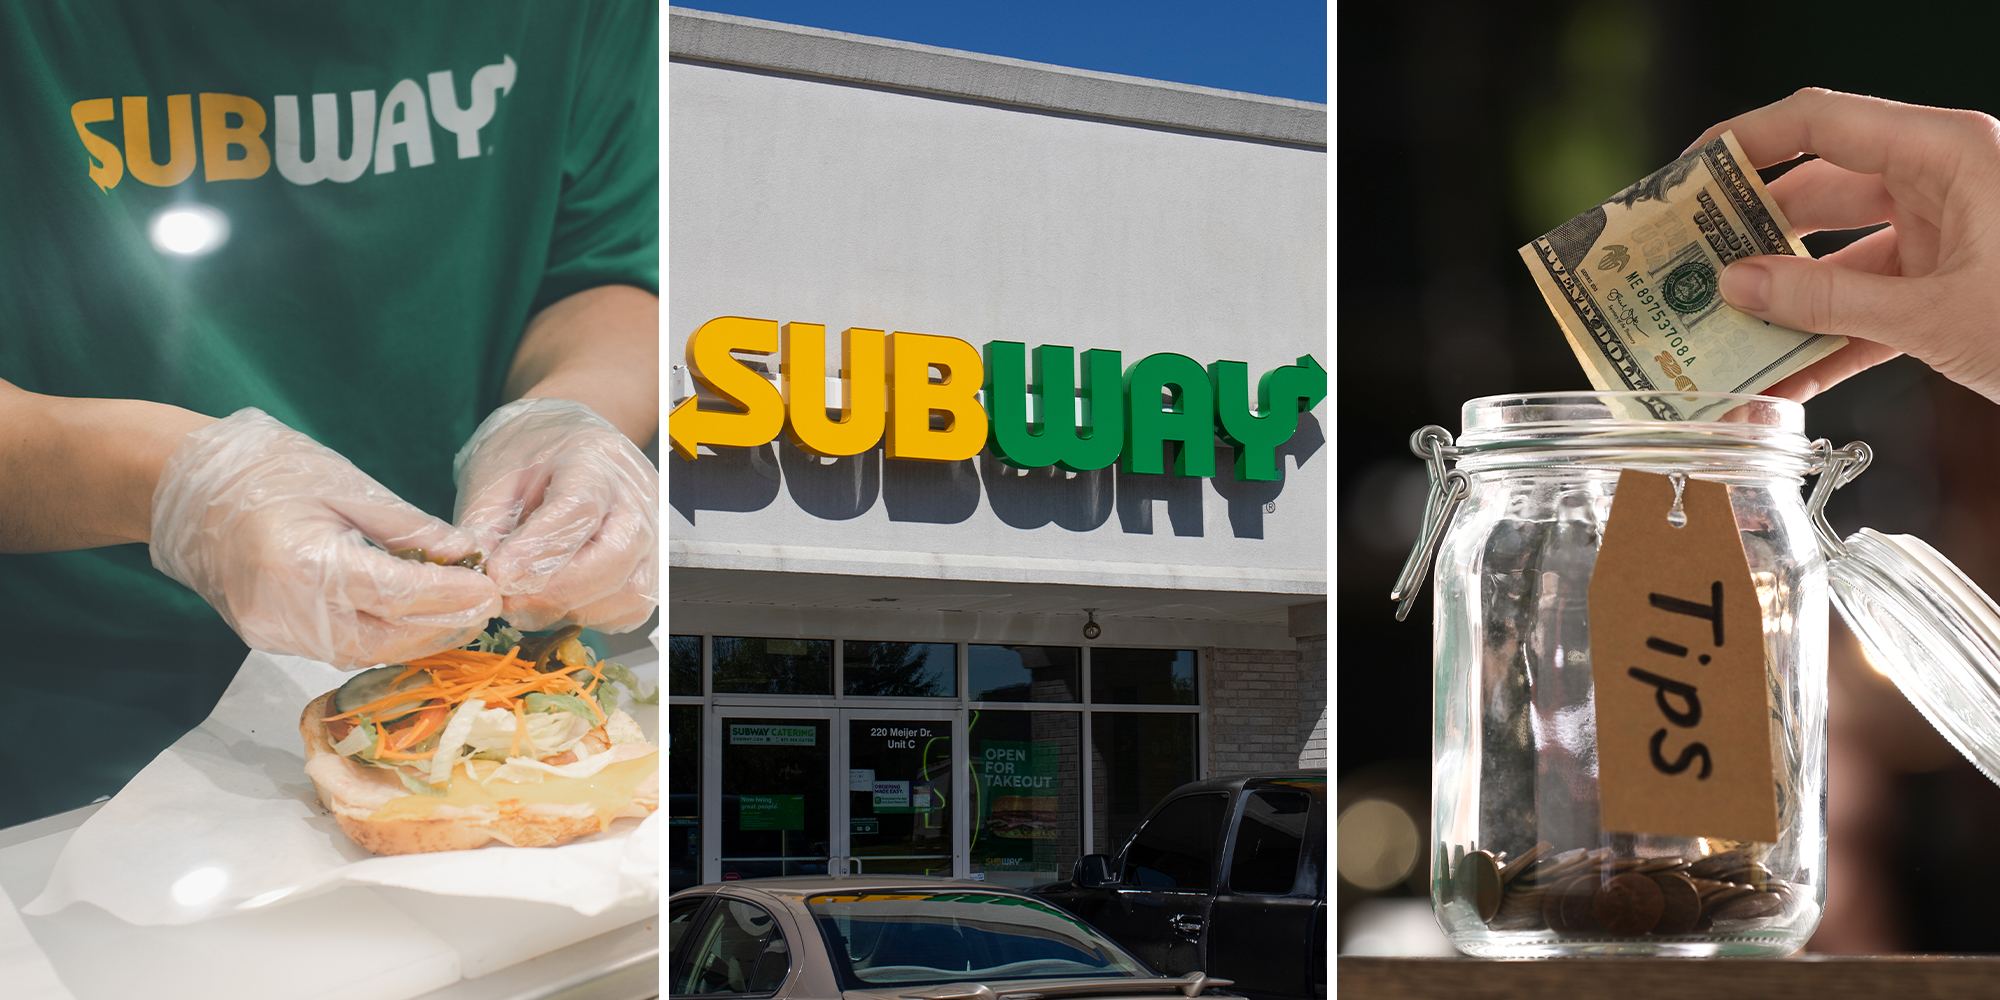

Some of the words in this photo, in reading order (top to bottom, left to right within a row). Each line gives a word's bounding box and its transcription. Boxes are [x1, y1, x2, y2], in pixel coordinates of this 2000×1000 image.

[71, 54, 517, 195] SUBWAY
[1716, 152, 1756, 210] RESERVE
[1695, 187, 1745, 254] UNITED
[1738, 232, 1757, 256] THE
[1535, 235, 1601, 328] TWENTY
[1654, 349, 1700, 403] 20
[669, 316, 1327, 481] SUBWAY
[1628, 581, 1724, 780] Tips
[732, 727, 770, 736] SUBWAY
[771, 728, 814, 737] CATERING
[870, 727, 888, 737] 220
[889, 728, 918, 738] Meijer
[920, 728, 933, 737] Dr.
[887, 739, 906, 749] Unit
[907, 740, 916, 749] C
[985, 748, 1026, 761] OPEN
[985, 762, 1015, 774] FOR
[985, 775, 1053, 788] TAKEOUT
[755, 796, 772, 804] hiring
[741, 803, 757, 811] great
[985, 858, 1022, 866] SUBWAY
